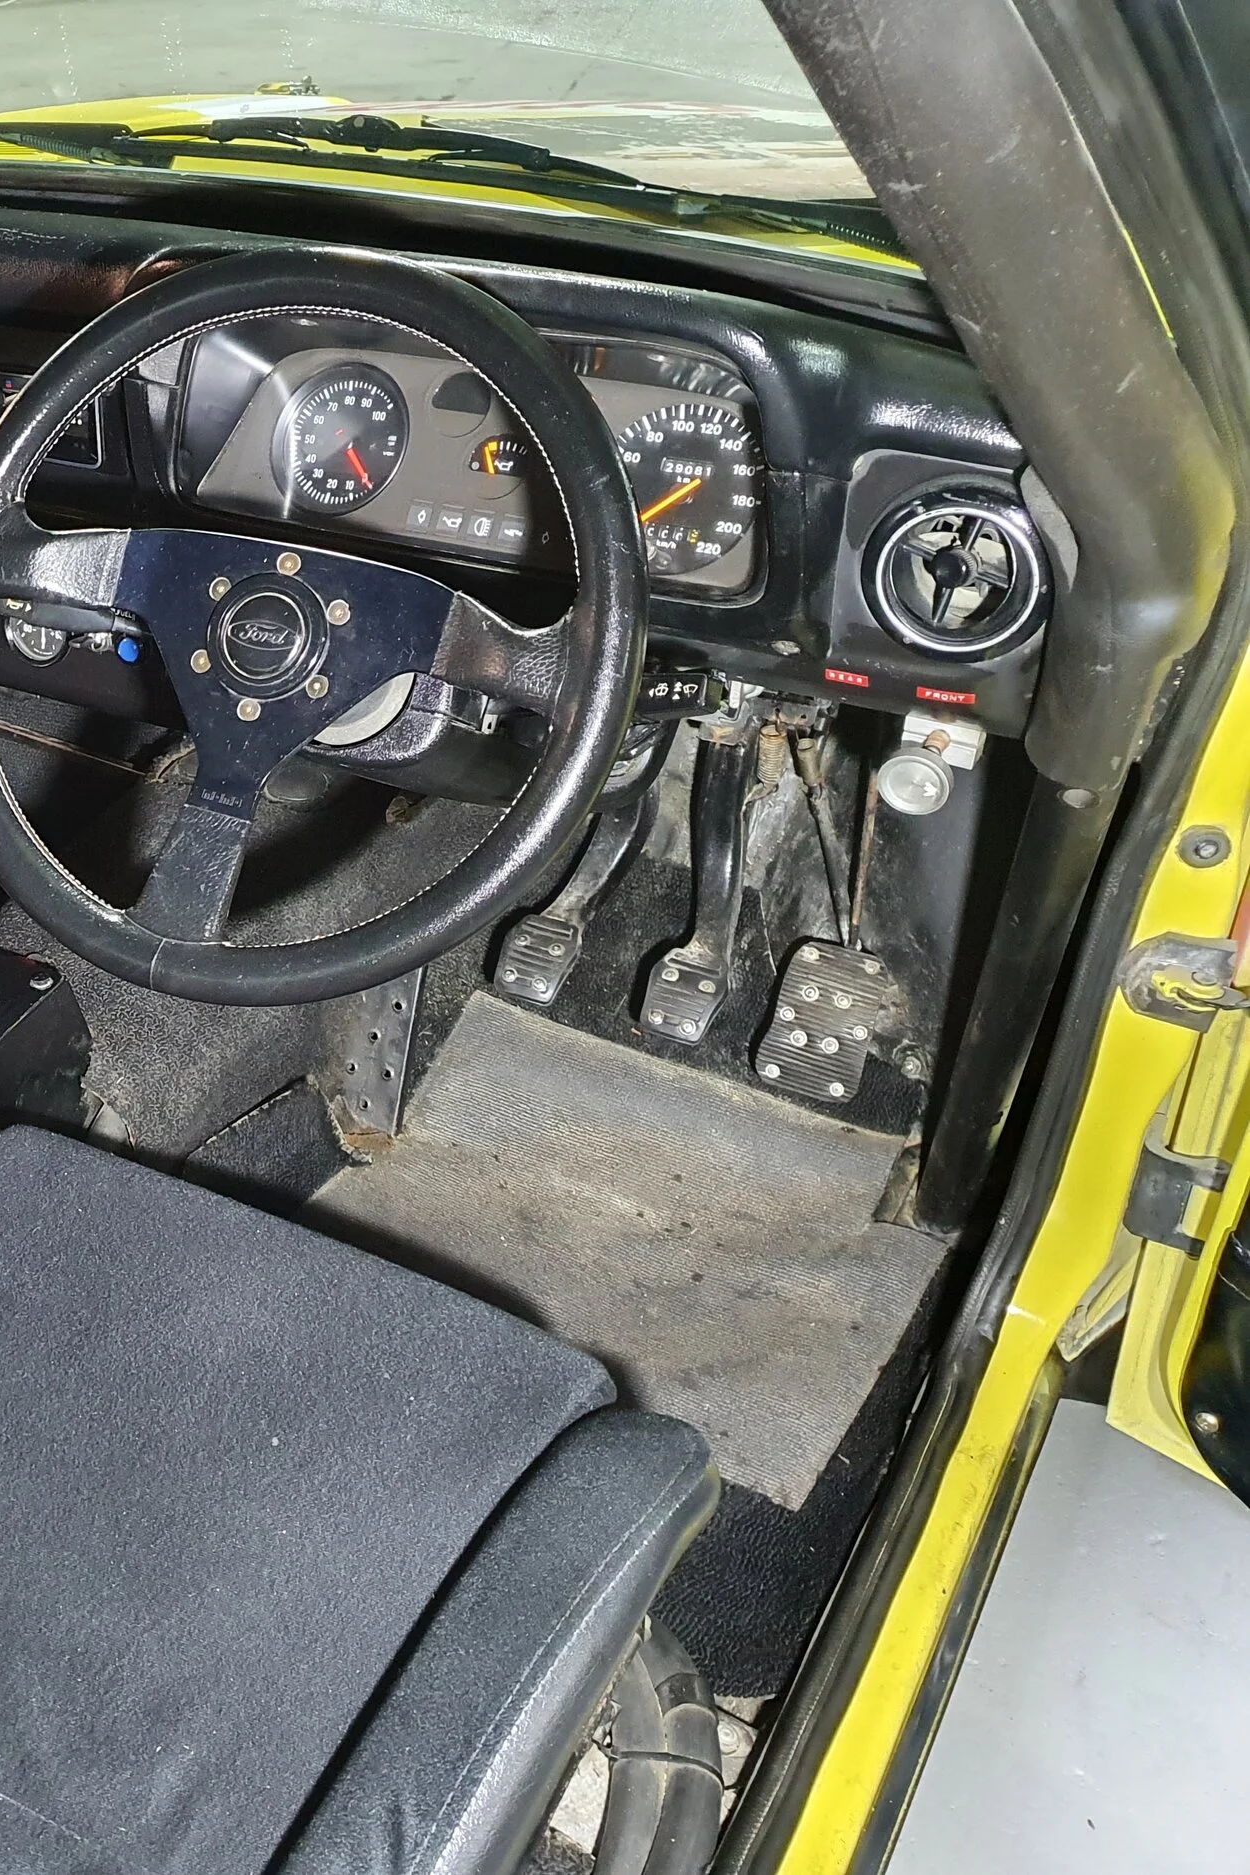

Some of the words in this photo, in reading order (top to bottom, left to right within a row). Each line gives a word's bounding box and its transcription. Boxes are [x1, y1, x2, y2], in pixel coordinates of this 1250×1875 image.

[344, 396, 355, 406] 80
[361, 398, 372, 408] 90
[327, 402, 338, 412] 70
[313, 415, 324, 425] 60
[372, 411, 386, 421] 100
[672, 420, 694, 432] 100
[700, 423, 722, 435] 120
[304, 434, 315, 445] 50
[646, 432, 663, 443] 80
[720, 438, 742, 450] 140
[305, 454, 316, 464] 40
[623, 452, 640, 463] 60
[312, 469, 323, 479] 30
[665, 463, 711, 476] 29081
[733, 464, 755, 476] 160
[327, 479, 338, 489] 20
[345, 480, 354, 490] 10
[732, 495, 755, 507] 180
[716, 522, 742, 534] 200
[656, 539, 677, 549] km/h
[696, 542, 721, 555] 220
[239, 623, 288, 645] Ford
[829, 672, 863, 683] REAR
[925, 691, 966, 702] FRONT
